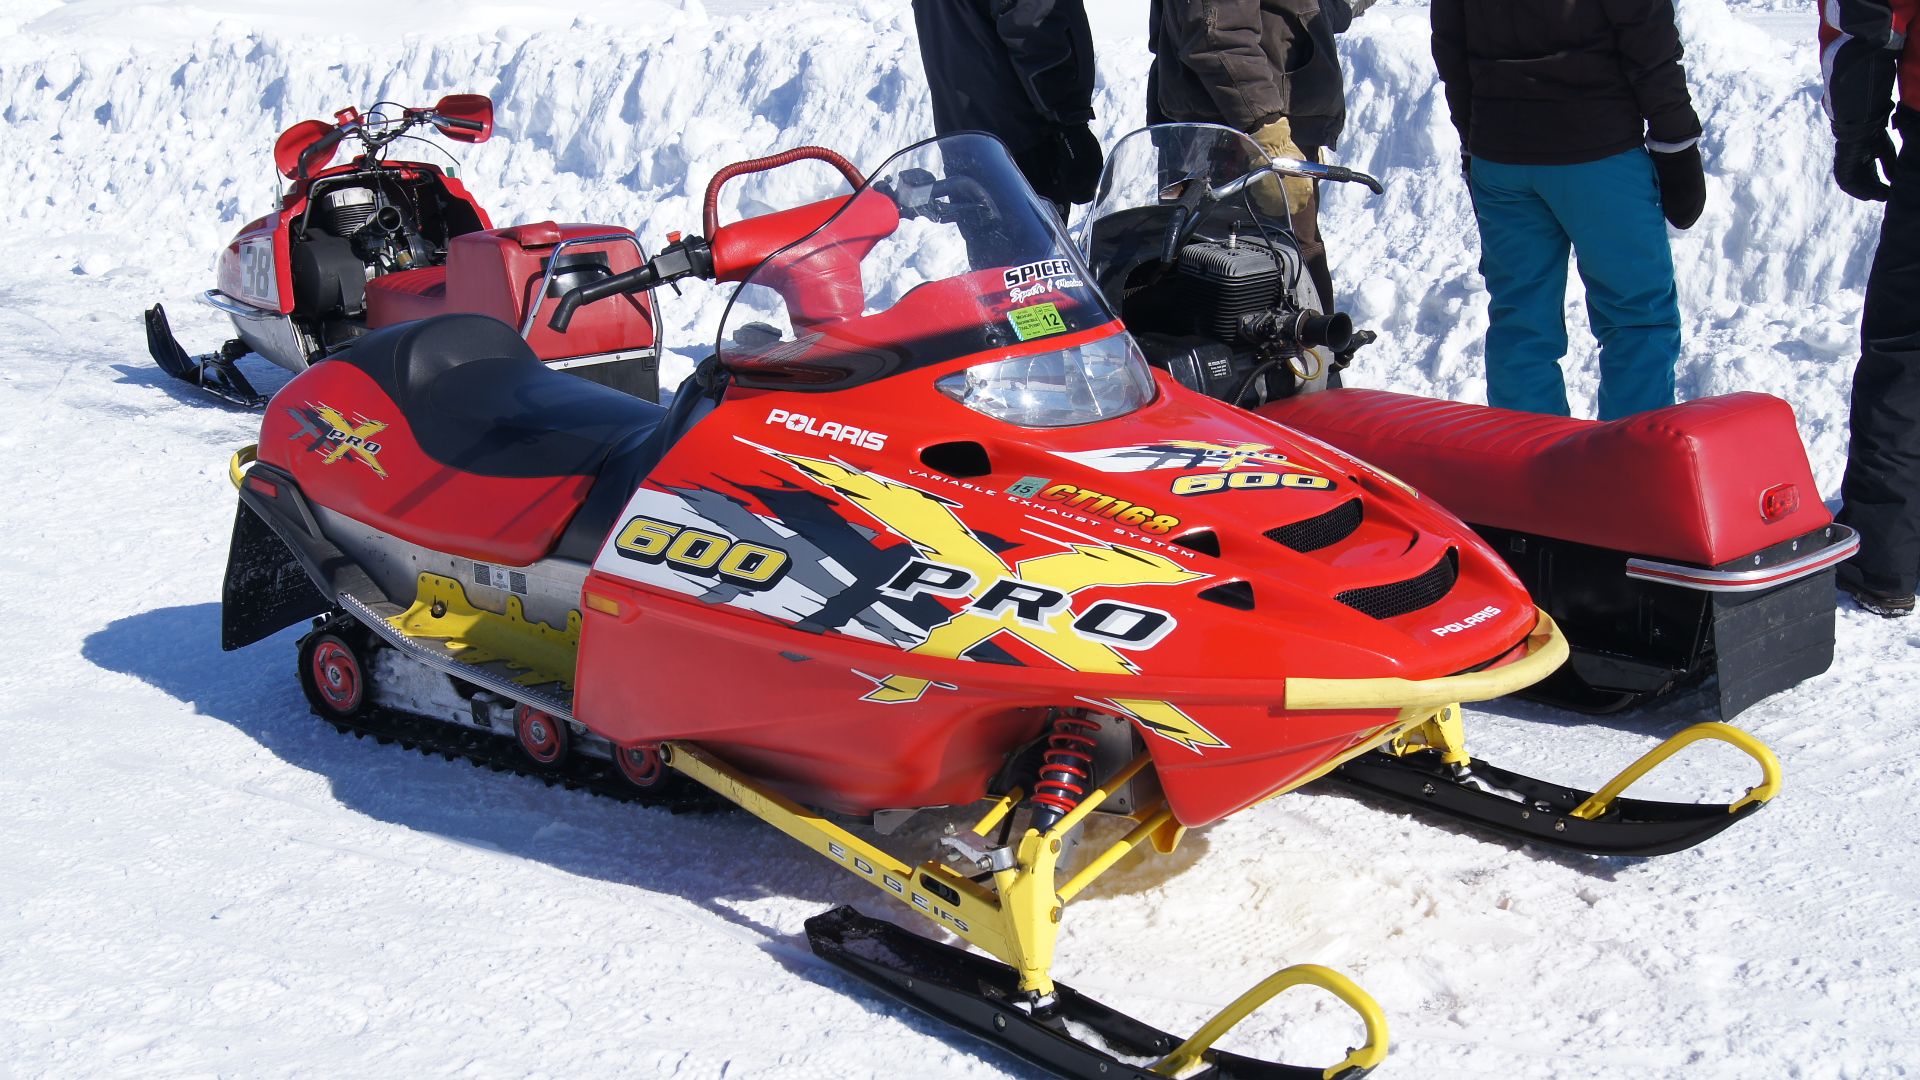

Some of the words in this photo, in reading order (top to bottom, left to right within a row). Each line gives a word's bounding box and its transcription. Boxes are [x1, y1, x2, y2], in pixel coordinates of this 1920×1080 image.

[243, 245, 272, 298] 38
[1005, 260, 1073, 287] SPICER
[1042, 313, 1060, 327] 12
[326, 428, 382, 455] PRO
[765, 408, 888, 452] POLARIS
[1204, 449, 1288, 461] PRO
[1012, 484, 1034, 494] 15
[1171, 472, 1337, 497] 600
[908, 469, 998, 496] VARIABLE
[1007, 495, 1101, 527] EXHAUST
[1113, 527, 1196, 558] SYSTEM
[1038, 484, 1181, 536] CT1168
[615, 515, 792, 592] 600
[877, 557, 1178, 650] PRO
[1431, 605, 1502, 637] POLARIS
[828, 841, 930, 912] EDGE
[933, 905, 969, 932] IFS
